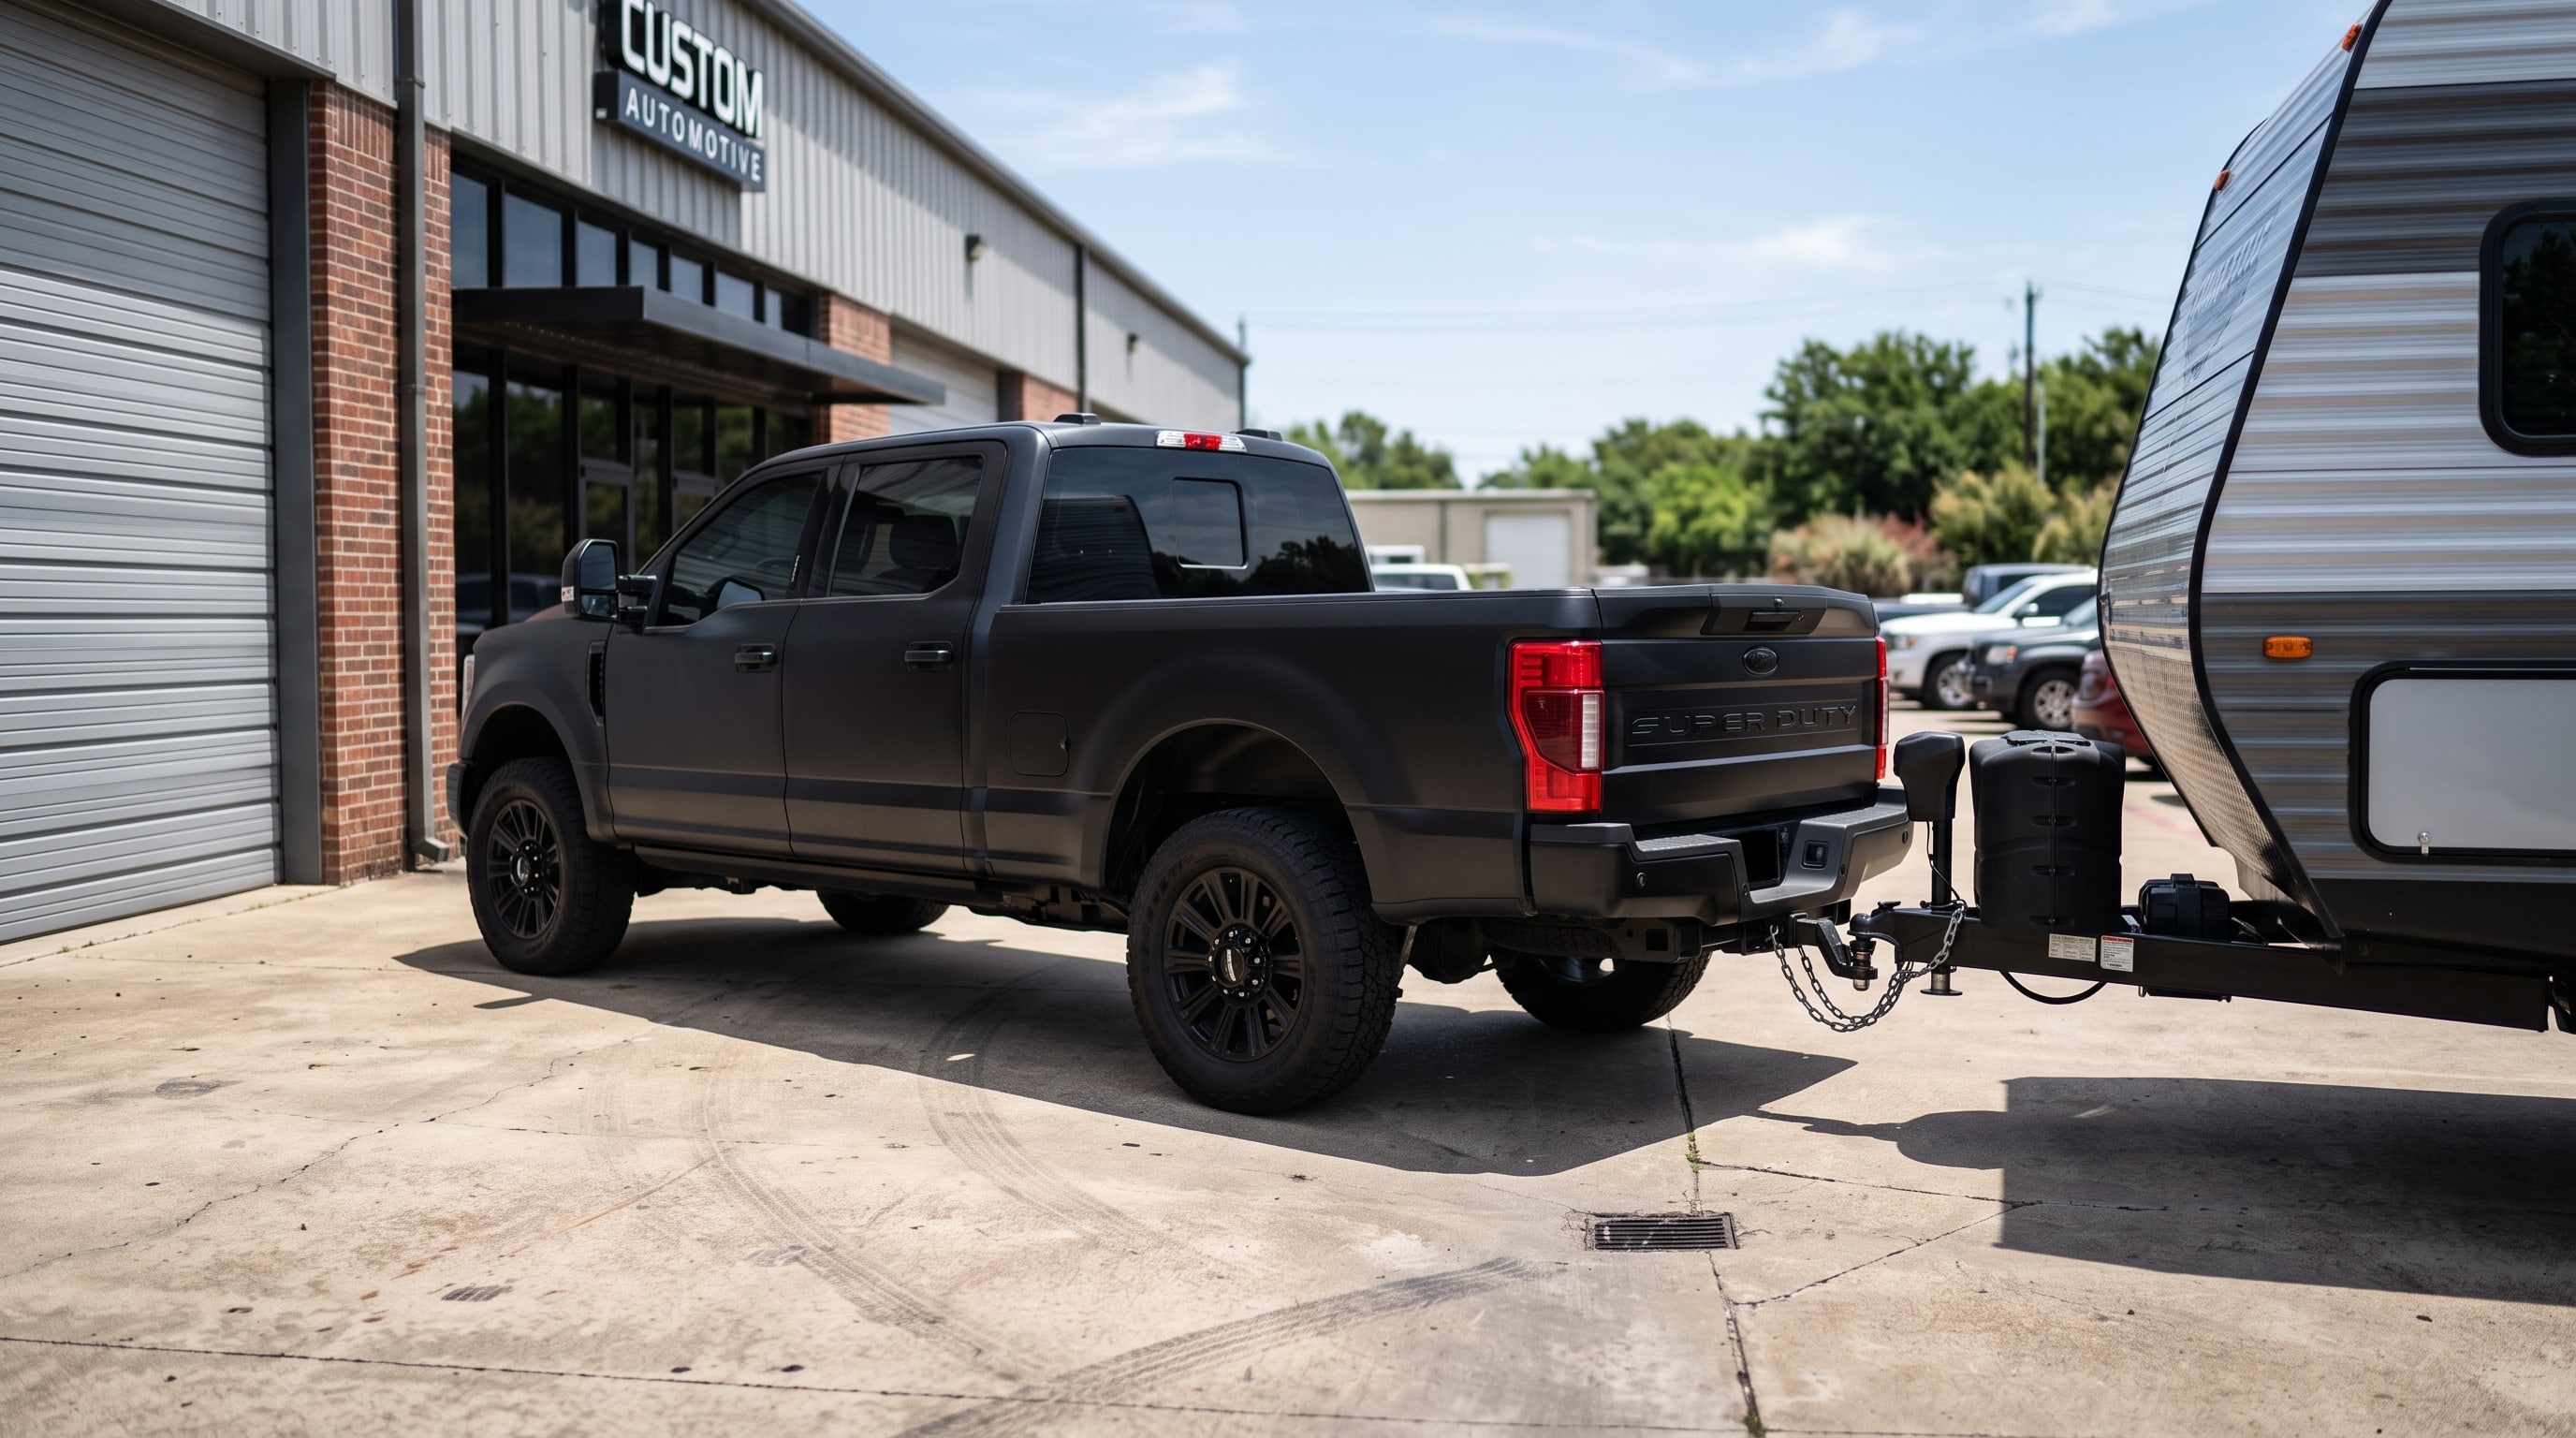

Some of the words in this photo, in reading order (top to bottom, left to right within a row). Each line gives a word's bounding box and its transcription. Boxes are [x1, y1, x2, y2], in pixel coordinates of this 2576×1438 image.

[621, 0, 763, 139] CUSTOM
[625, 87, 761, 183] AUTOMOTIVE
[1632, 712, 1766, 737] SUPER
[1777, 705, 1856, 728] DUTY
